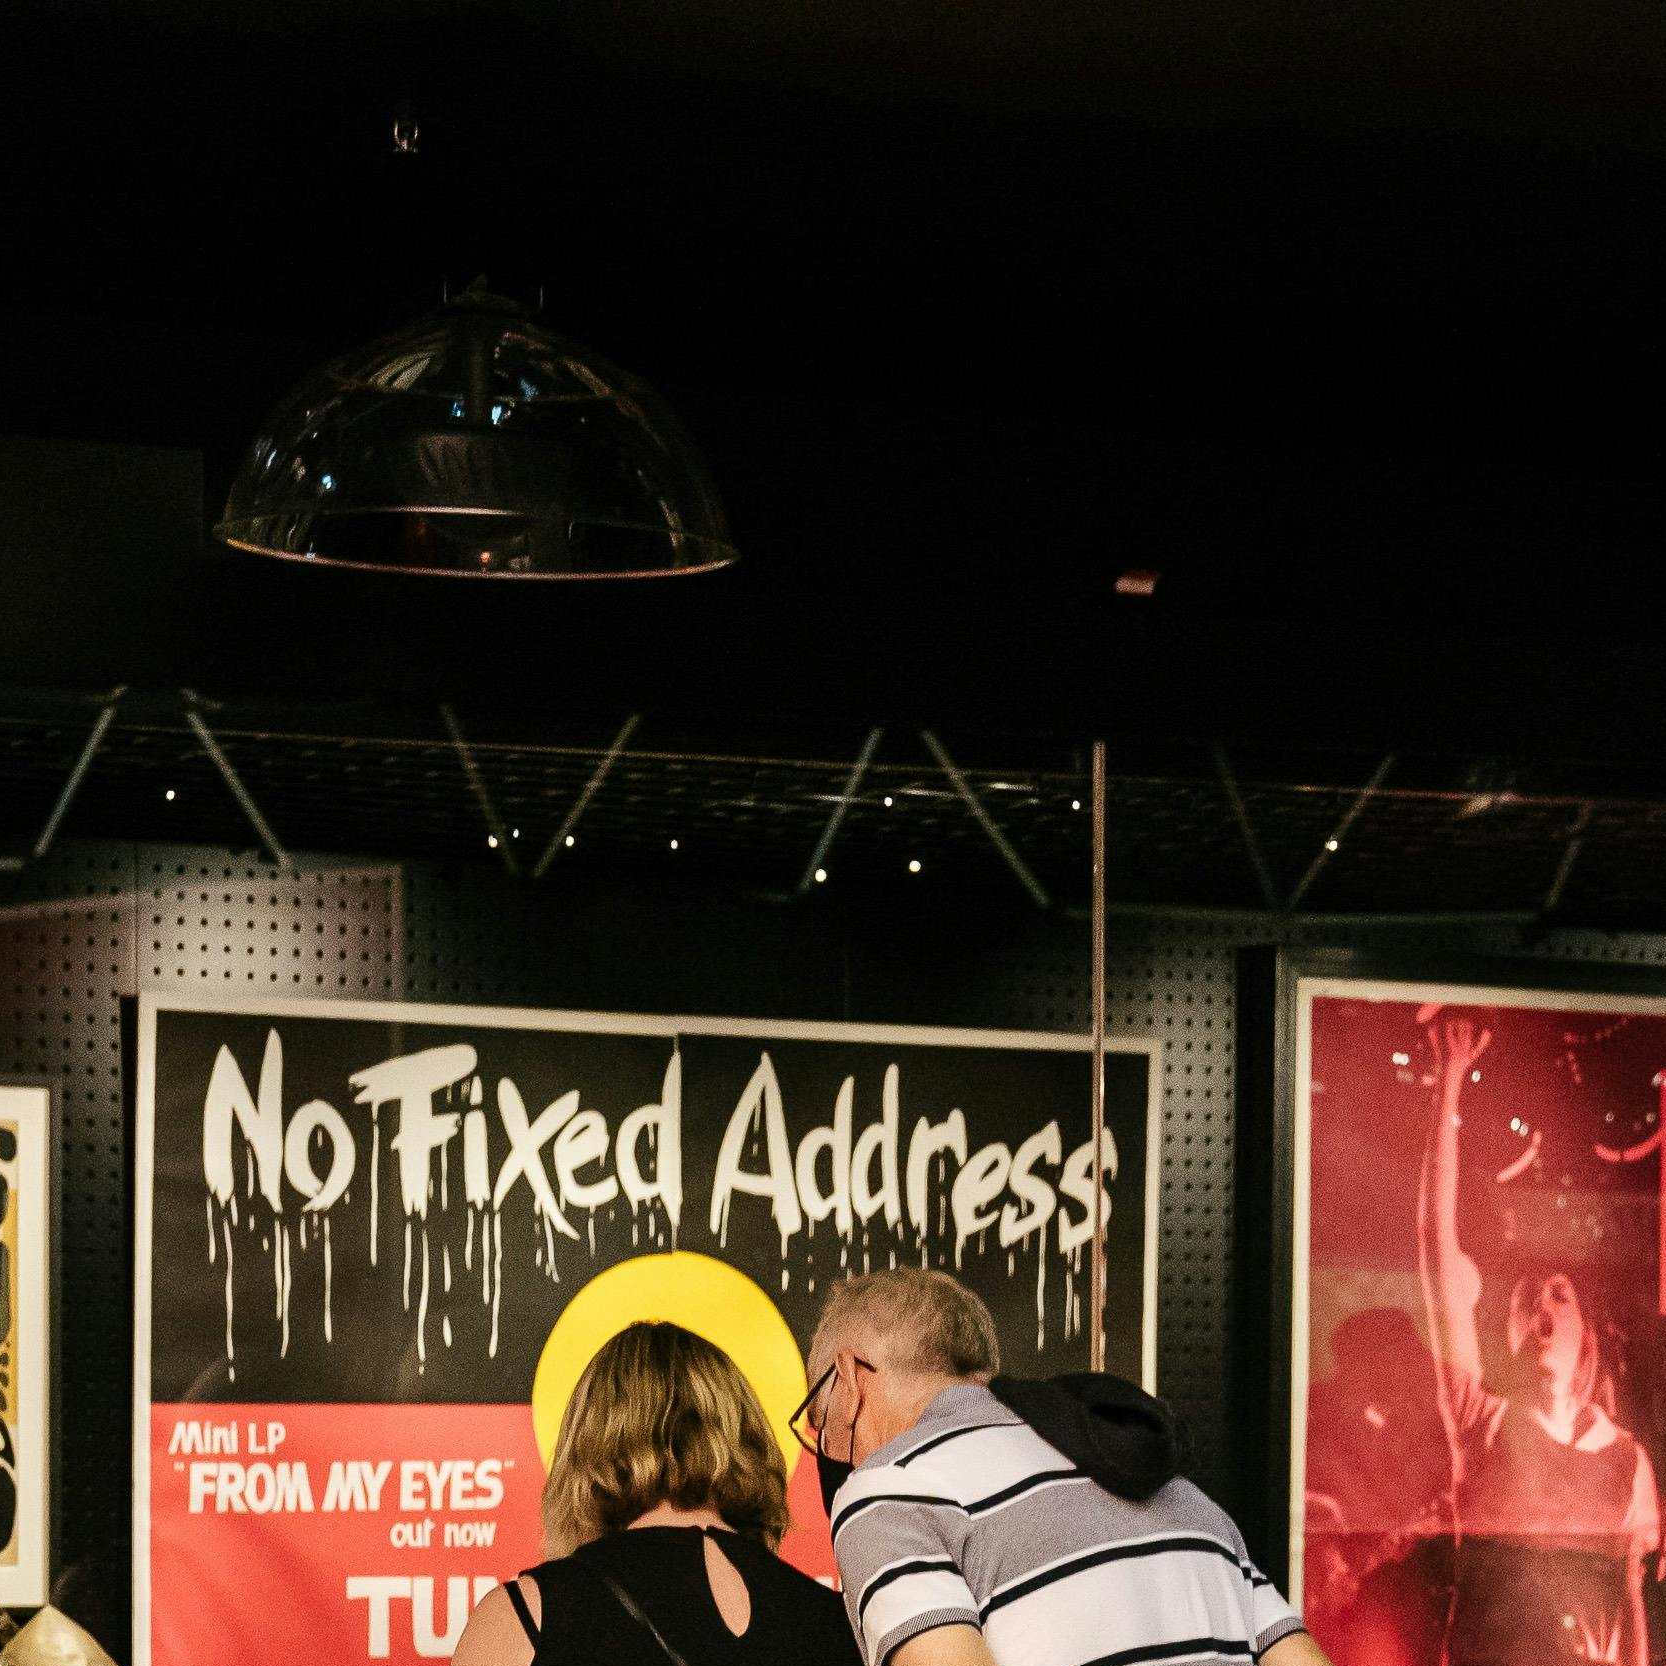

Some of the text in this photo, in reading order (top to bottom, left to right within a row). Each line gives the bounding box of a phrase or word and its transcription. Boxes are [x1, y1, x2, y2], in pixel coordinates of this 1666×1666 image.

[202, 1026, 357, 1222] No
[348, 1038, 685, 1242] Fixed
[709, 1050, 1120, 1255] Address
[168, 1421, 287, 1455] Mini LP
[173, 1458, 516, 1514] "FROM MY EYES"
[389, 1519, 497, 1549] out now
[345, 1575, 500, 1659] TU
